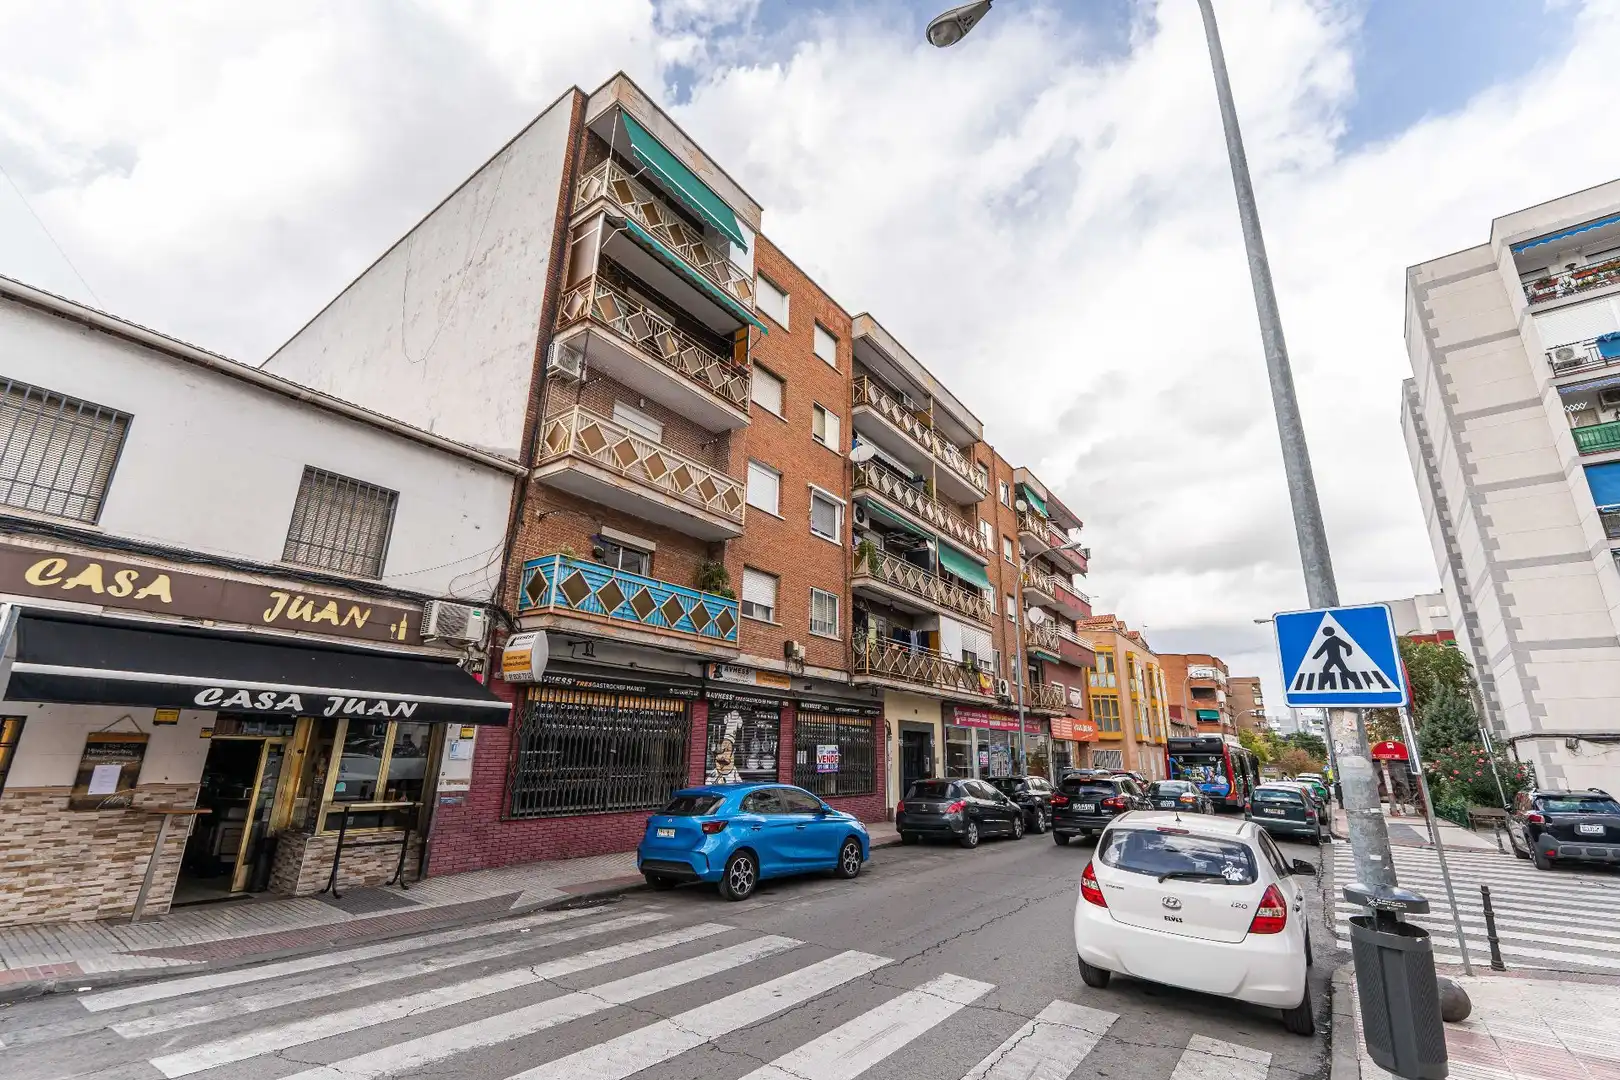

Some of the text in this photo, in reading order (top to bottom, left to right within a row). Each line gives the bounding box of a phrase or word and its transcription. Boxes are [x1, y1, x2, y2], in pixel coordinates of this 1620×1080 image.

[25, 558, 371, 628] CASA JUAN
[194, 688, 418, 718] CASA JUAN
[817, 755, 838, 763] VENDE
